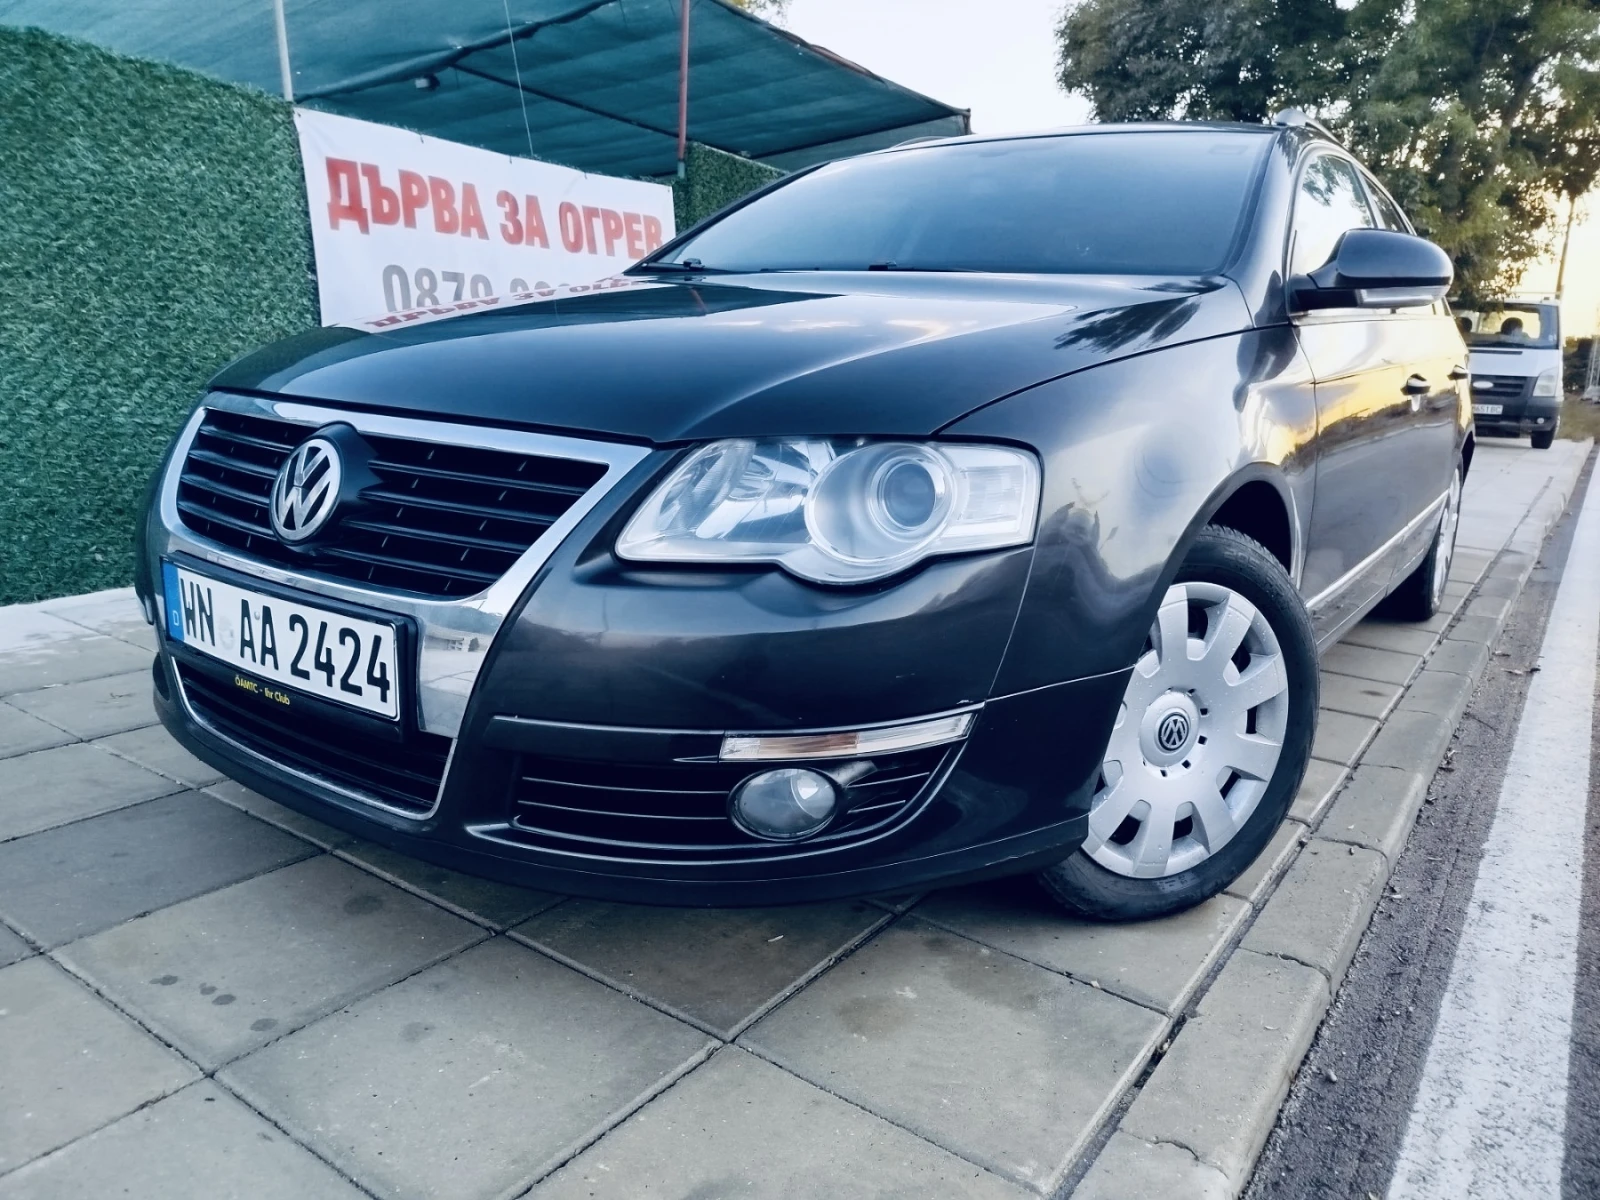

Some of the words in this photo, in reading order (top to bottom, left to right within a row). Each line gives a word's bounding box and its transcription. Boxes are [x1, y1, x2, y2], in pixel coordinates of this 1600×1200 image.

[325, 156, 490, 241] ДЪРВА
[496, 190, 550, 249] ЗА
[558, 201, 663, 260] ОГРЕВ
[180, 578, 216, 647] WN
[240, 598, 279, 671] AA
[289, 613, 391, 704] 2424
[274, 691, 290, 705] Club
